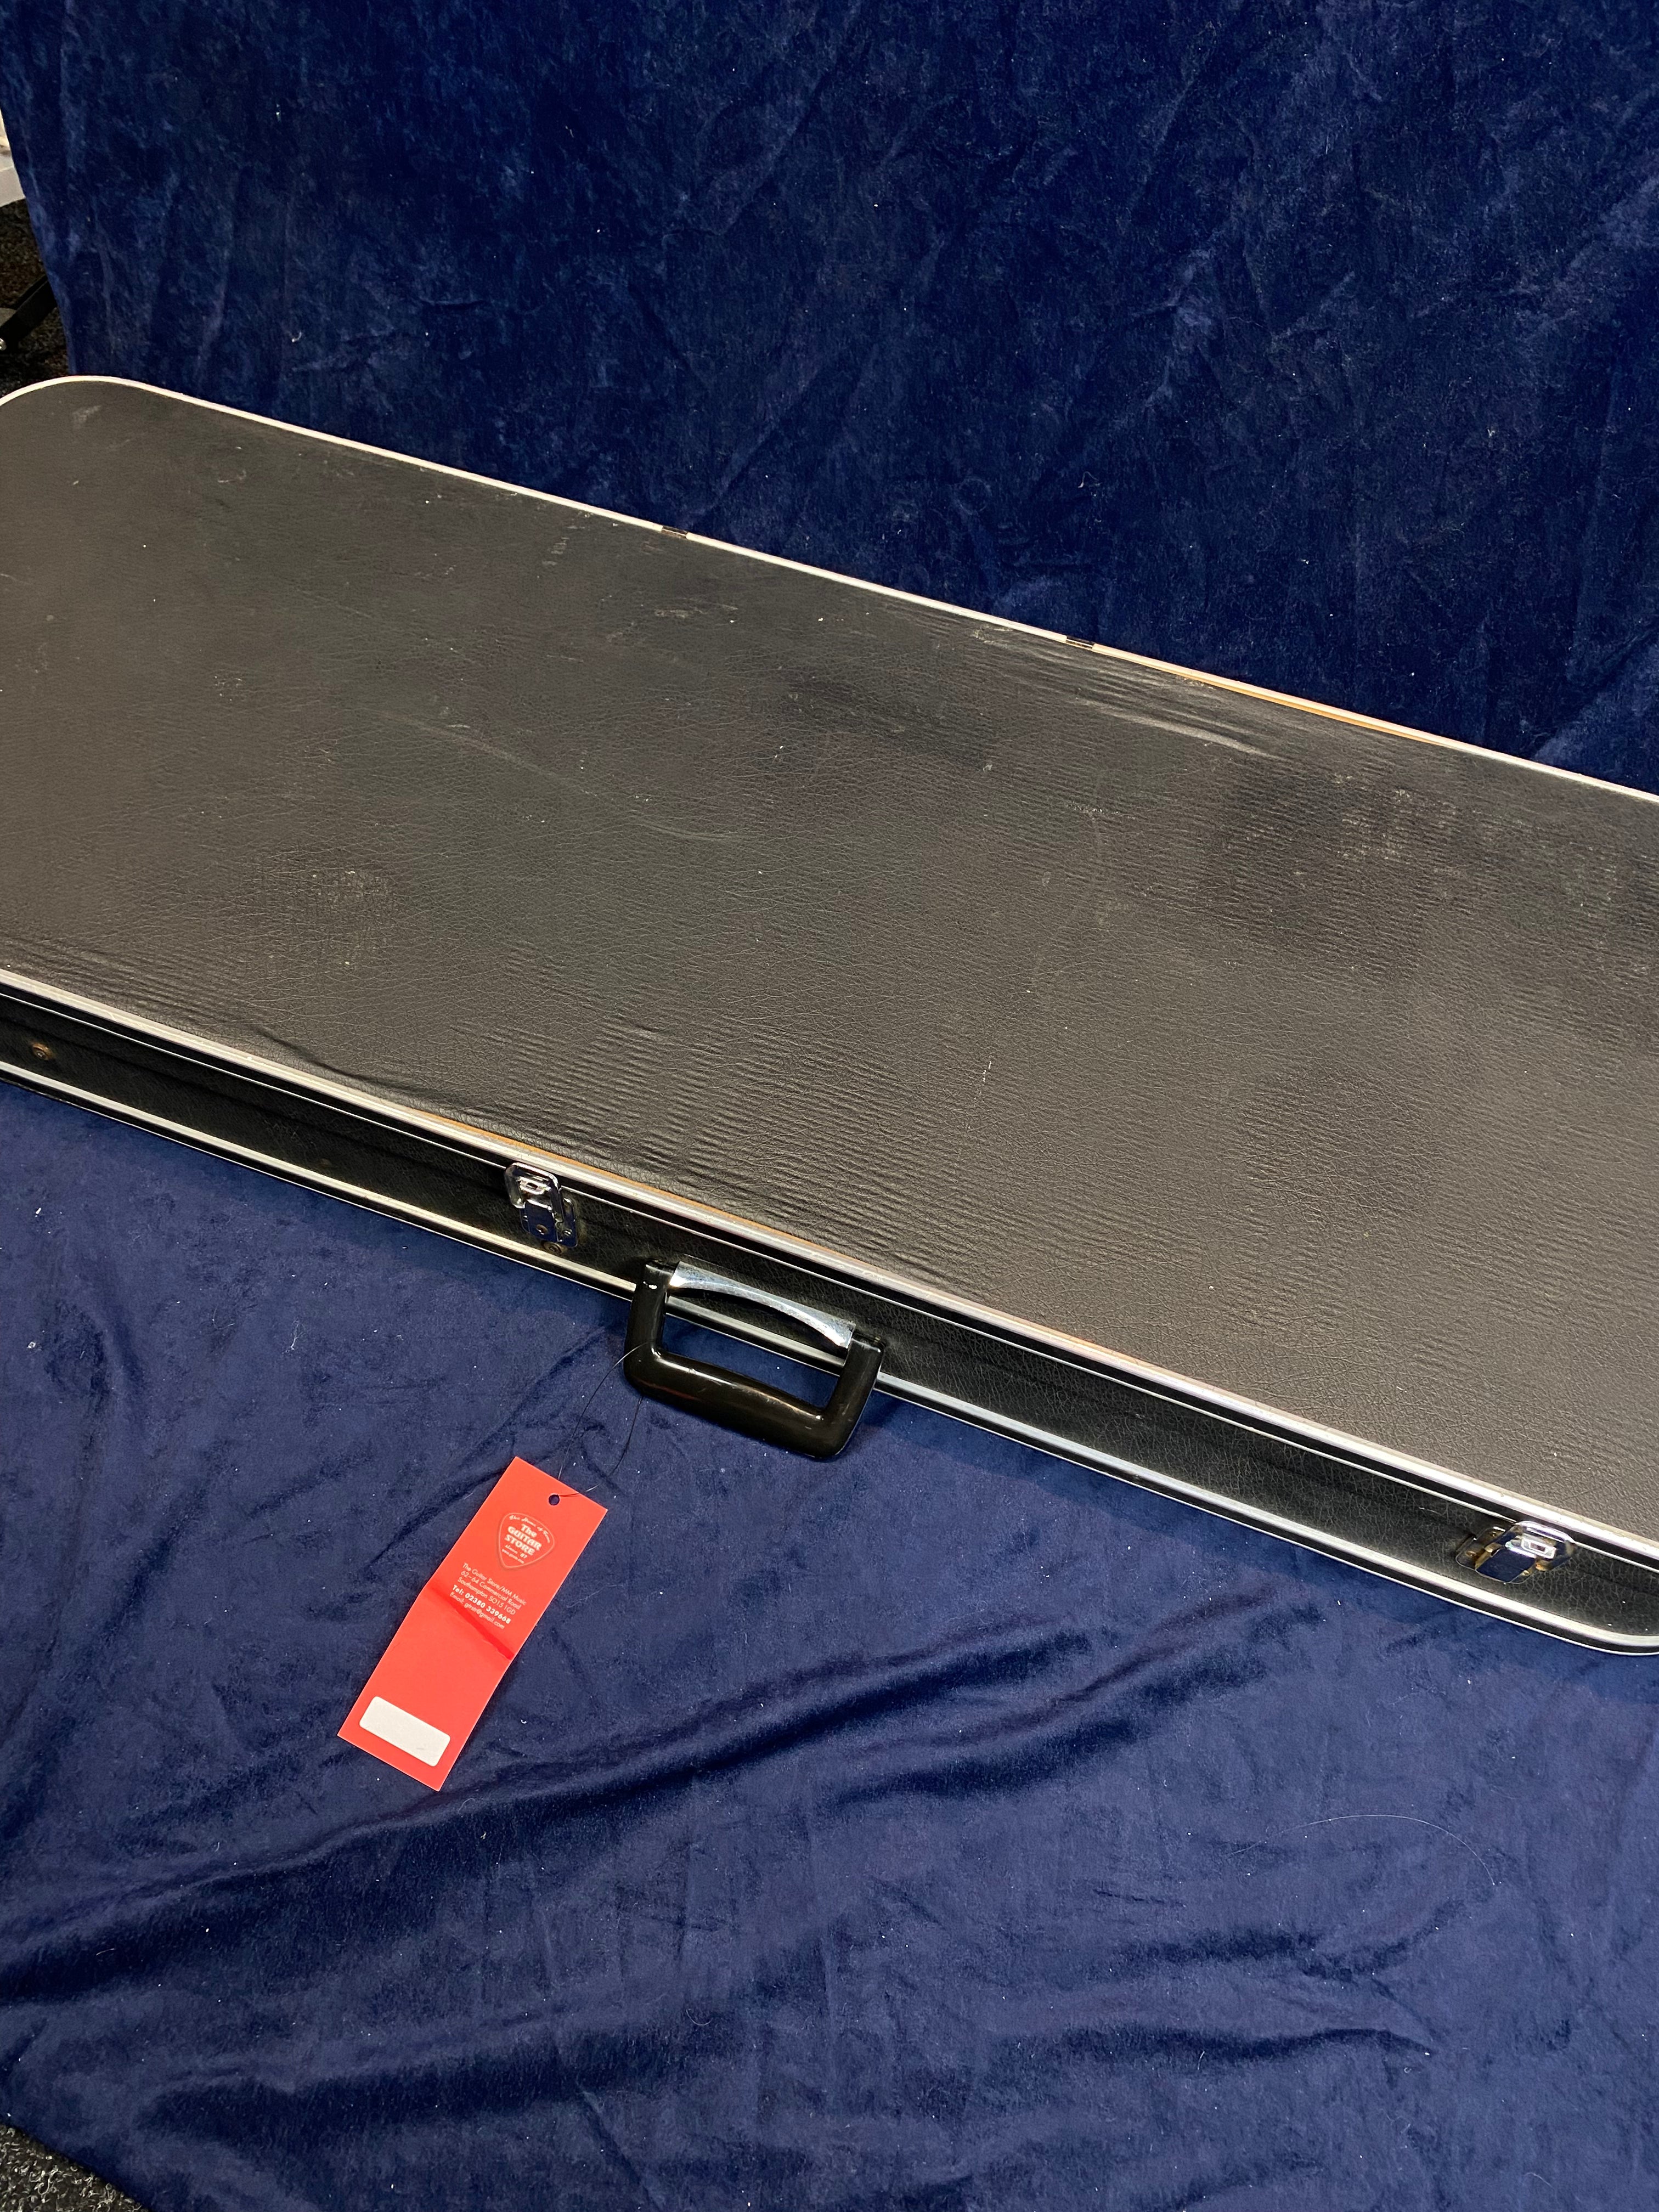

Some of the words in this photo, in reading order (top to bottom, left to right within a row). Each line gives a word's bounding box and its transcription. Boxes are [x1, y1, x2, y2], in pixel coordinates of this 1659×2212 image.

[508, 1526, 542, 1551] GUITAR
[521, 1523, 537, 1538] The
[504, 1534, 535, 1555] STORE
[458, 1577, 488, 1598] Southampton
[488, 1596, 504, 1607] SO15
[504, 1605, 516, 1615] 1GD
[462, 1562, 471, 1571] The
[472, 1569, 487, 1581] Guitar
[487, 1578, 512, 1596] Store/MM
[512, 1594, 527, 1605] Music
[479, 1582, 508, 1601] Commercial
[507, 1599, 522, 1610] Road
[450, 1592, 464, 1604] Email:
[453, 1584, 464, 1595] Tel:
[465, 1593, 486, 1608] 02380
[486, 1606, 511, 1624] 339668
